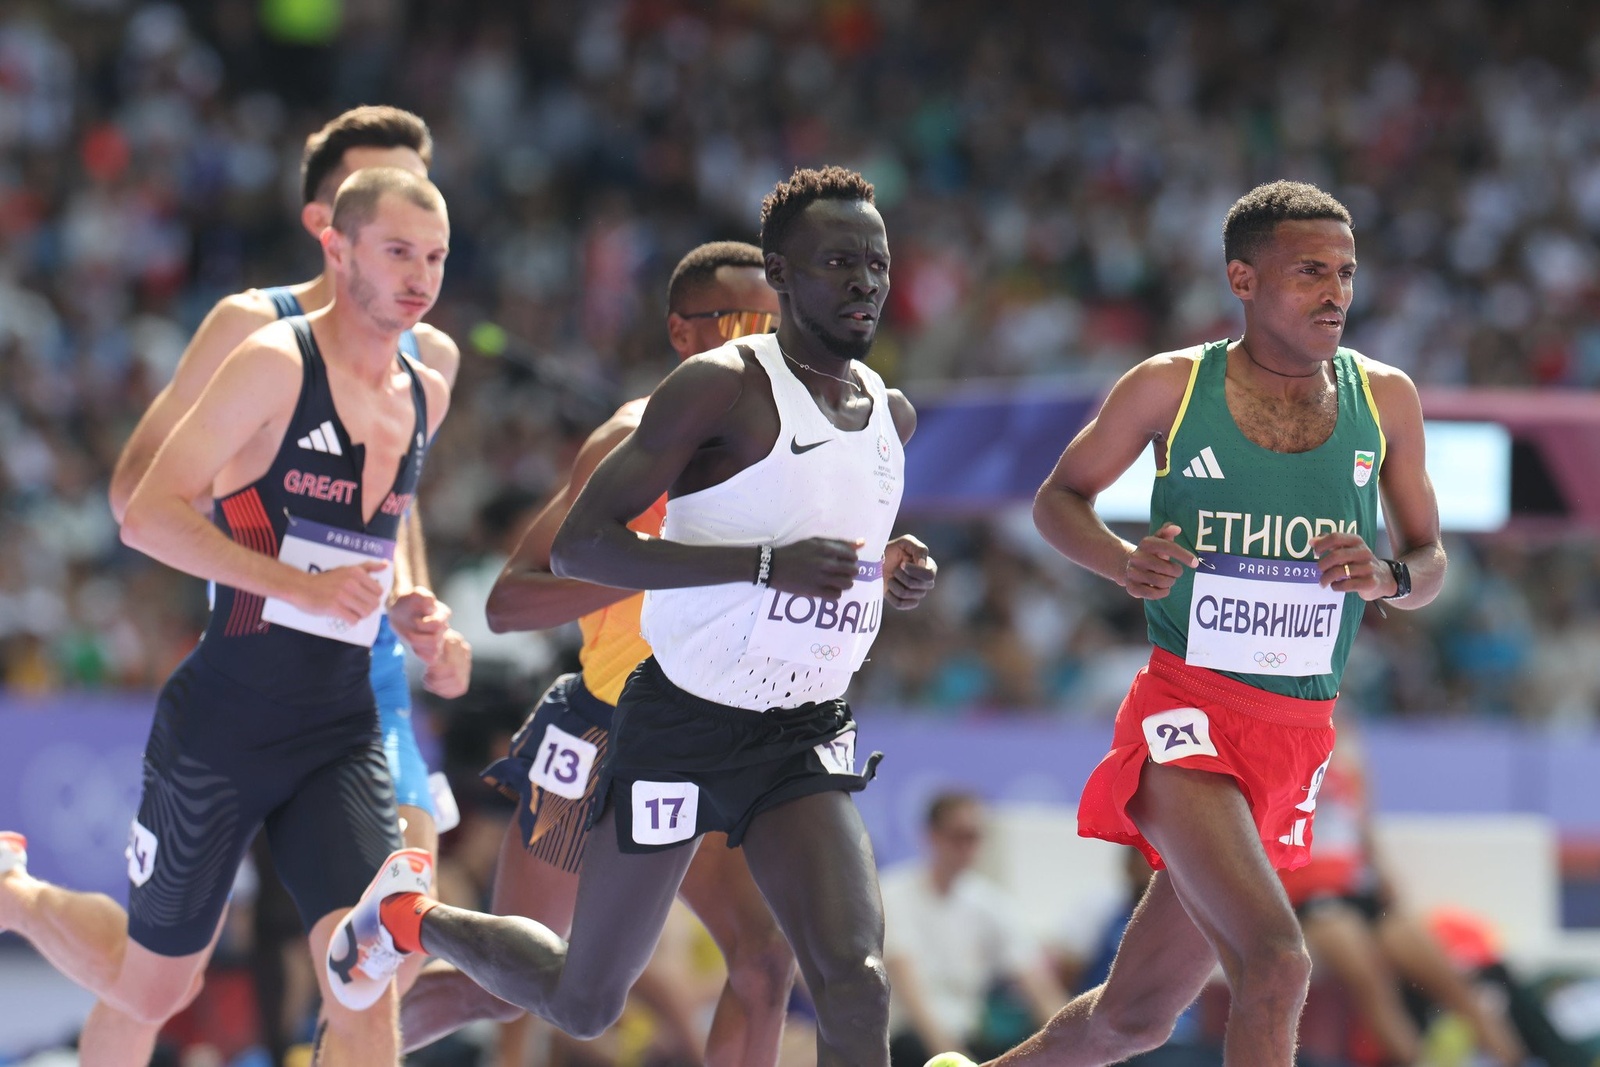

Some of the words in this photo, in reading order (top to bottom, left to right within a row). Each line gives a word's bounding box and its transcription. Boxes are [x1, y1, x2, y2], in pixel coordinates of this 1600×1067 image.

[283, 469, 358, 505] GREAT
[1284, 566, 1317, 578] 2024
[1196, 594, 1338, 638] GEBRHIWET
[1156, 723, 1201, 751] 21
[543, 742, 580, 784] 13
[822, 741, 849, 771] 17
[645, 797, 685, 830] 17
